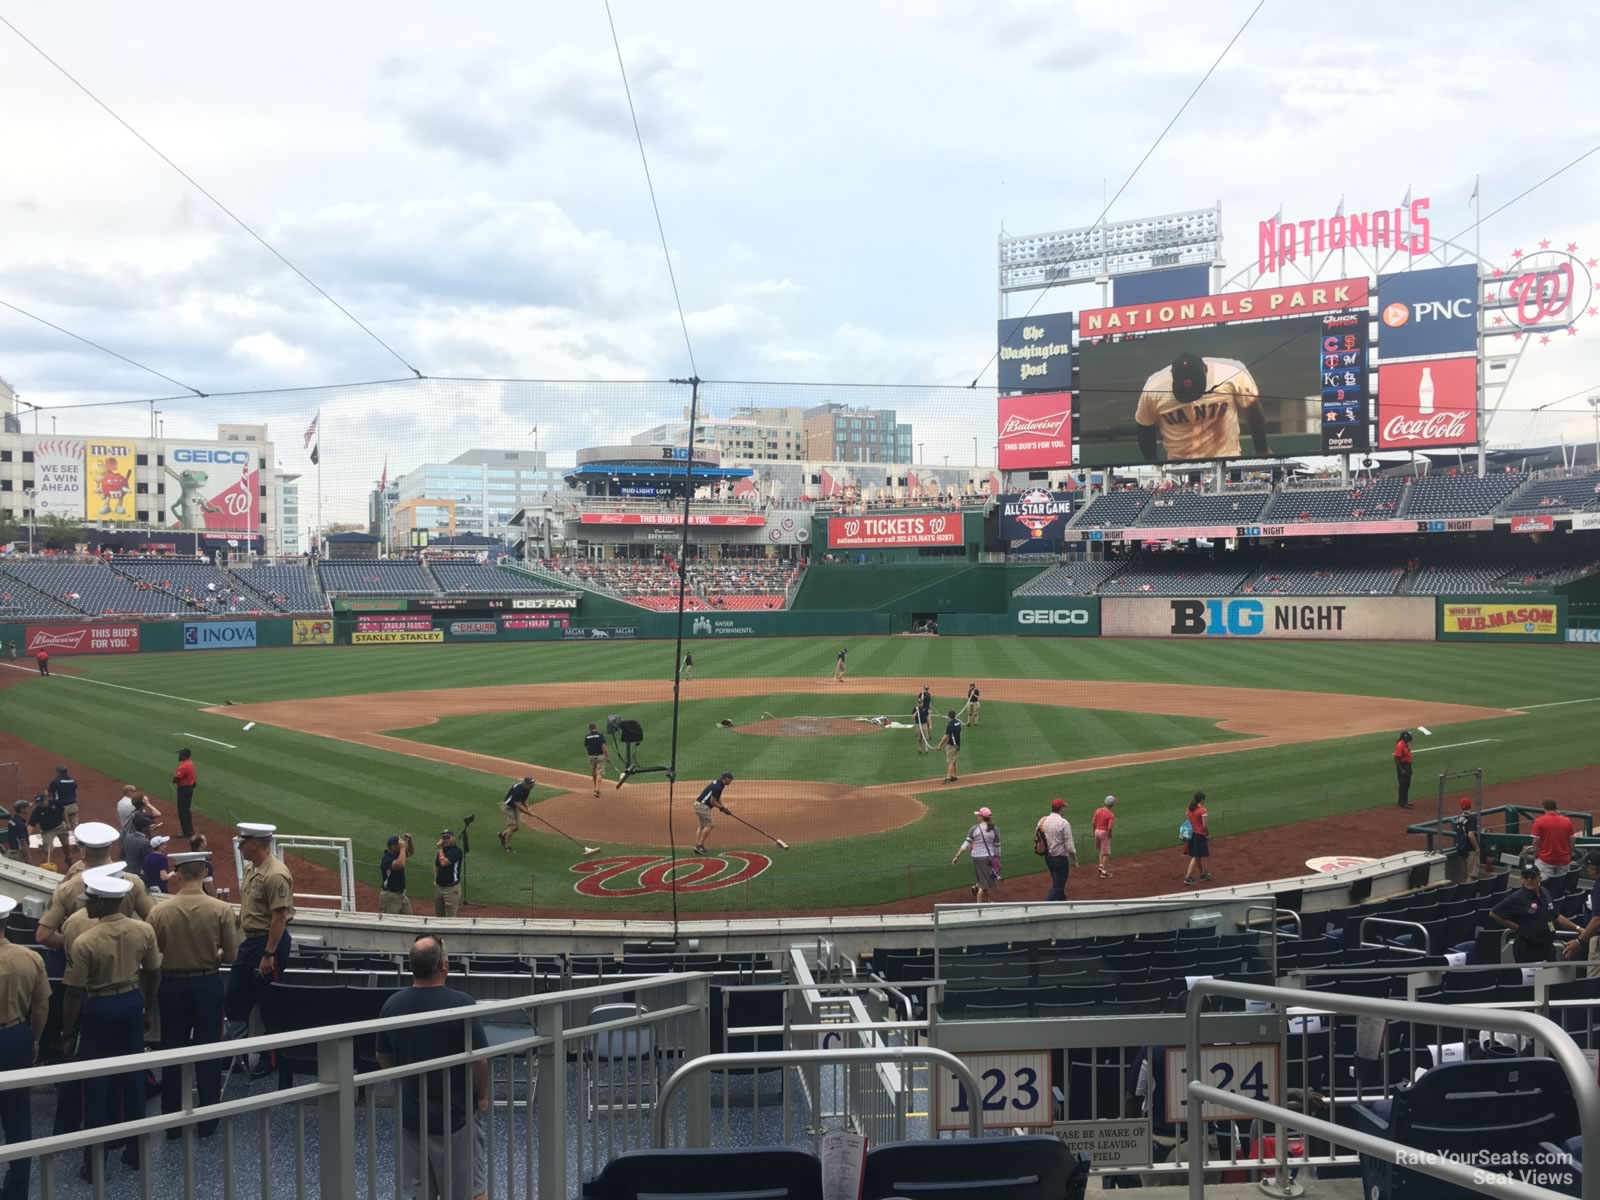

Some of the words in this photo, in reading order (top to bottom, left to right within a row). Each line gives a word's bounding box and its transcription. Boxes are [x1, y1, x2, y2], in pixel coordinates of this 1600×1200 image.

[1258, 197, 1430, 274] NATIONALS
[1088, 298, 1253, 330] NATIONALS
[1270, 285, 1352, 310] PARK
[1413, 298, 1473, 323] PNC
[1022, 326, 1045, 341] The
[1000, 343, 1069, 361] Washington
[1020, 362, 1047, 381] Post
[1006, 420, 1063, 433] Budweiser
[1383, 411, 1471, 442] Coca-Cola
[1004, 443, 1018, 451] THIS
[1018, 442, 1037, 450] BUD'S
[1038, 441, 1050, 449] FOR
[1051, 440, 1066, 448] YOU.
[1329, 438, 1353, 446] Degree
[174, 449, 250, 465] GEICO
[41, 465, 58, 473] WE
[61, 465, 79, 473] SEE
[41, 484, 79, 492] AHEAD
[1004, 504, 1021, 516] ALL
[1022, 503, 1045, 515] STAR
[1046, 502, 1071, 514] GAME
[640, 515, 656, 524] THIS
[657, 515, 679, 524] BUD'S
[680, 516, 694, 524] FR
[864, 518, 924, 535] TICKETS
[1263, 526, 1284, 536] NIGHT
[1448, 520, 1472, 531] NIGHT
[837, 536, 876, 544] nationals.com
[1104, 531, 1124, 539] NIGHT
[546, 599, 577, 609] FAN
[1018, 609, 1089, 624] GEICO
[1466, 607, 1482, 615] BUT
[1274, 605, 1346, 631] NIGHT
[91, 629, 110, 638] THIS
[112, 628, 138, 637] BUD'S
[203, 627, 255, 642] INOVA
[355, 633, 397, 642] STANLEY
[400, 632, 440, 641] STANLEY
[35, 635, 80, 645] Budweiser
[91, 639, 107, 648] FOR
[110, 639, 129, 648] YOU.
[950, 1067, 1040, 1112] 123
[1083, 1130, 1095, 1139] BE
[1098, 1129, 1130, 1138] AWARE
[1133, 1128, 1146, 1137] OF
[1068, 1142, 1095, 1151] JECTS
[1098, 1140, 1137, 1150] LEAVING
[1093, 1152, 1121, 1161] FIELD
